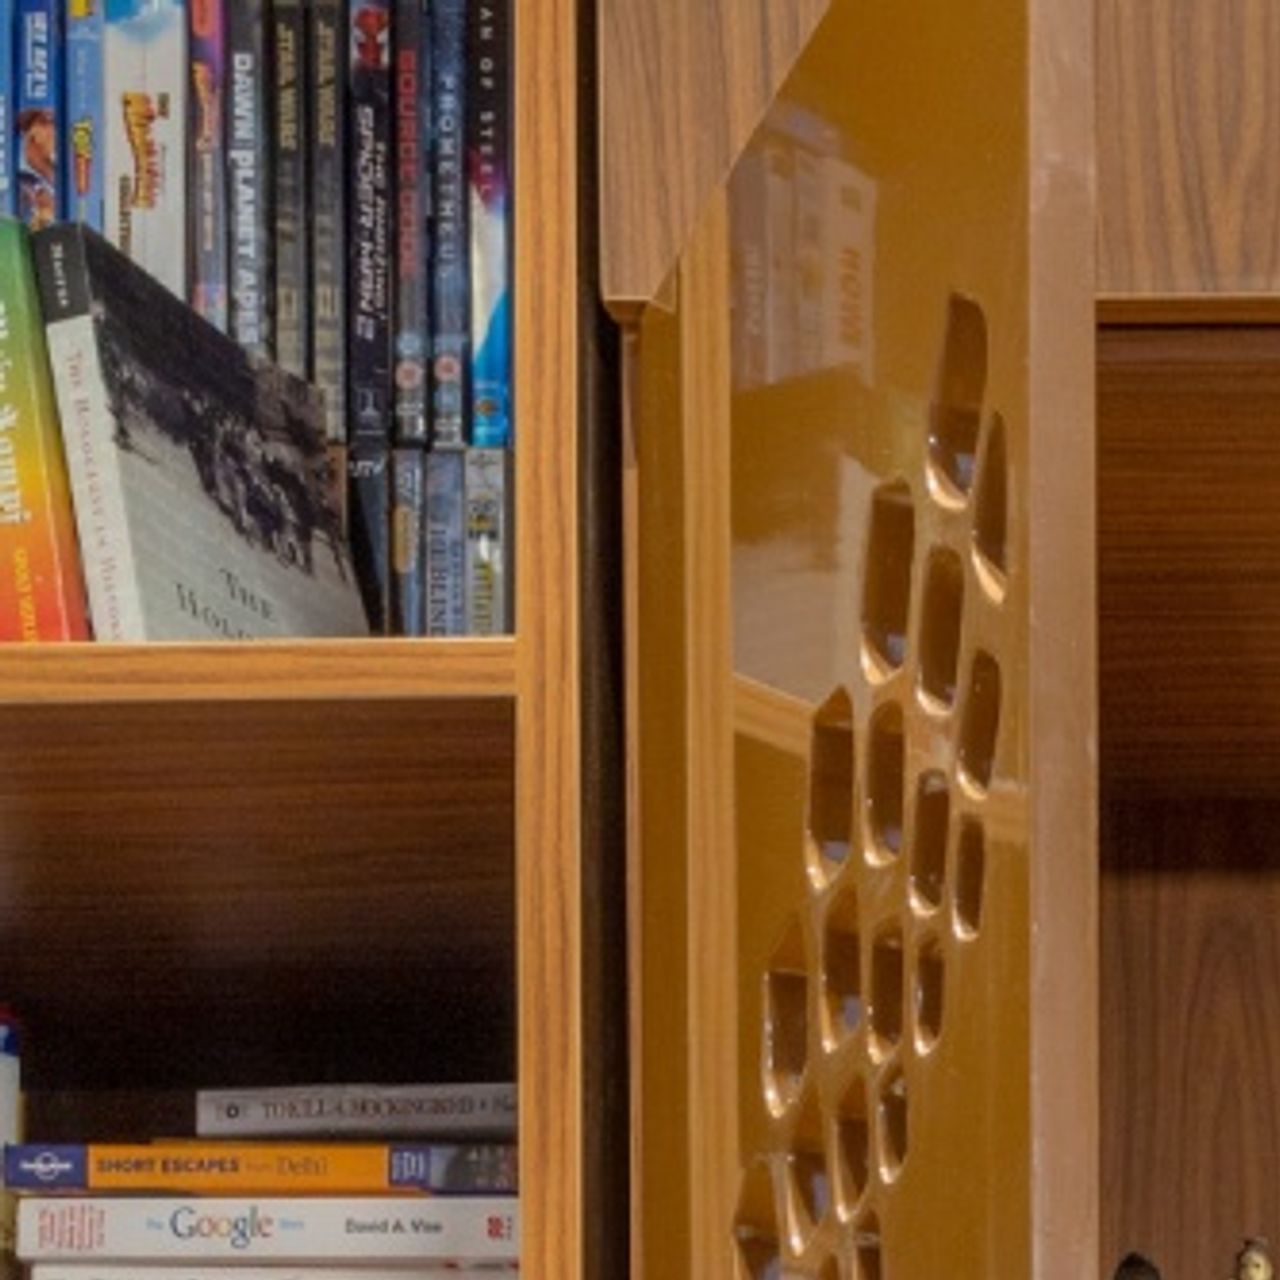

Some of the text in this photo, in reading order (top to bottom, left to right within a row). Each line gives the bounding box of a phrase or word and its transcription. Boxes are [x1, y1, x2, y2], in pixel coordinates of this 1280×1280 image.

[479, 57, 494, 90] OF
[277, 87, 297, 150] WARS
[317, 85, 335, 148] WARS
[439, 73, 456, 279] PROMETHEUS
[479, 111, 494, 195] STEEL
[228, 53, 259, 344] DAWN PLANET APES
[97, 1157, 155, 1174] SHORT
[160, 1157, 239, 1174] ESCAPES
[169, 1204, 275, 1250] Google
[345, 1216, 388, 1235] David
